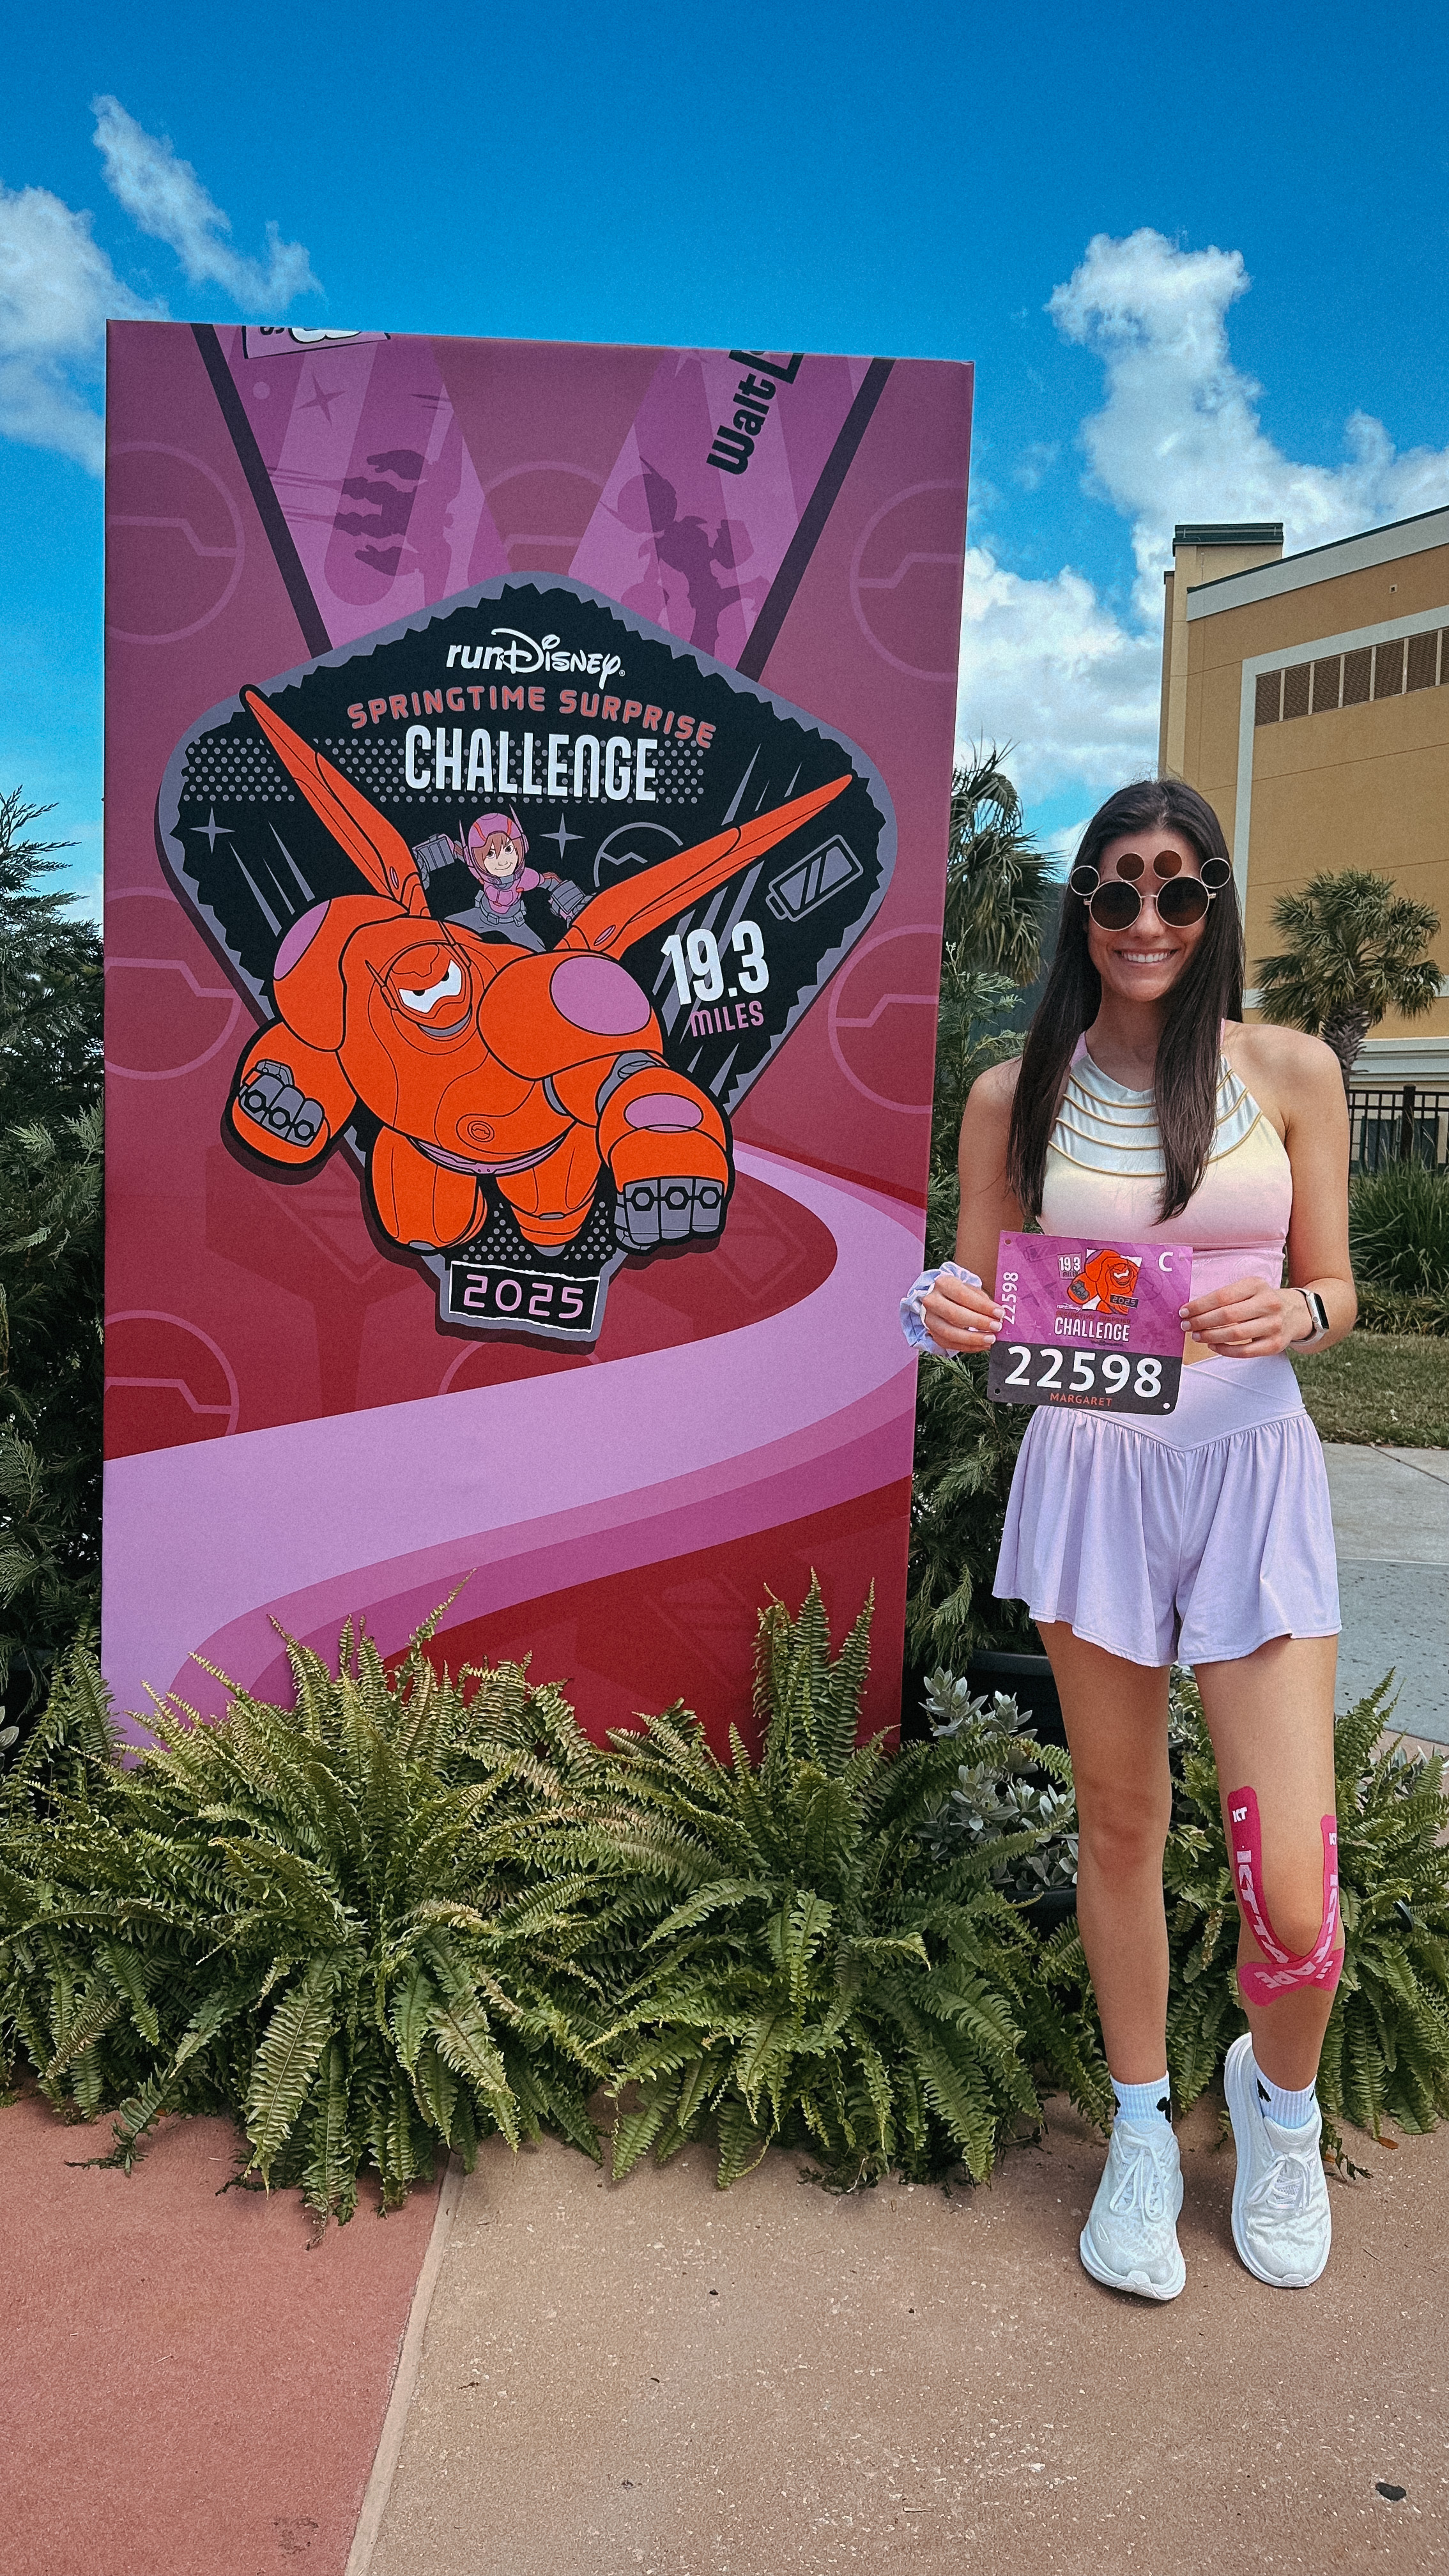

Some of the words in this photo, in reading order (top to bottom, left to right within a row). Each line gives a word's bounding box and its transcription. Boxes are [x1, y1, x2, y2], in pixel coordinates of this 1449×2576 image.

[706, 373, 776, 475] Walt
[347, 686, 546, 730] SPRINGTIME
[559, 690, 717, 749] SURPRISE
[405, 725, 659, 801] CHALLENGE
[661, 920, 769, 1006] 19.3
[691, 1000, 764, 1037] MILES
[1059, 1256, 1081, 1271] 19.3
[1158, 1251, 1174, 1272] C
[463, 1274, 583, 1319] 2025
[1112, 1296, 1137, 1307] 2025
[1054, 1317, 1130, 1342] CHALLENGE
[1004, 1346, 1163, 1398] 22598
[1049, 1392, 1114, 1406] MARGARET
[1232, 1806, 1248, 1823] KT
